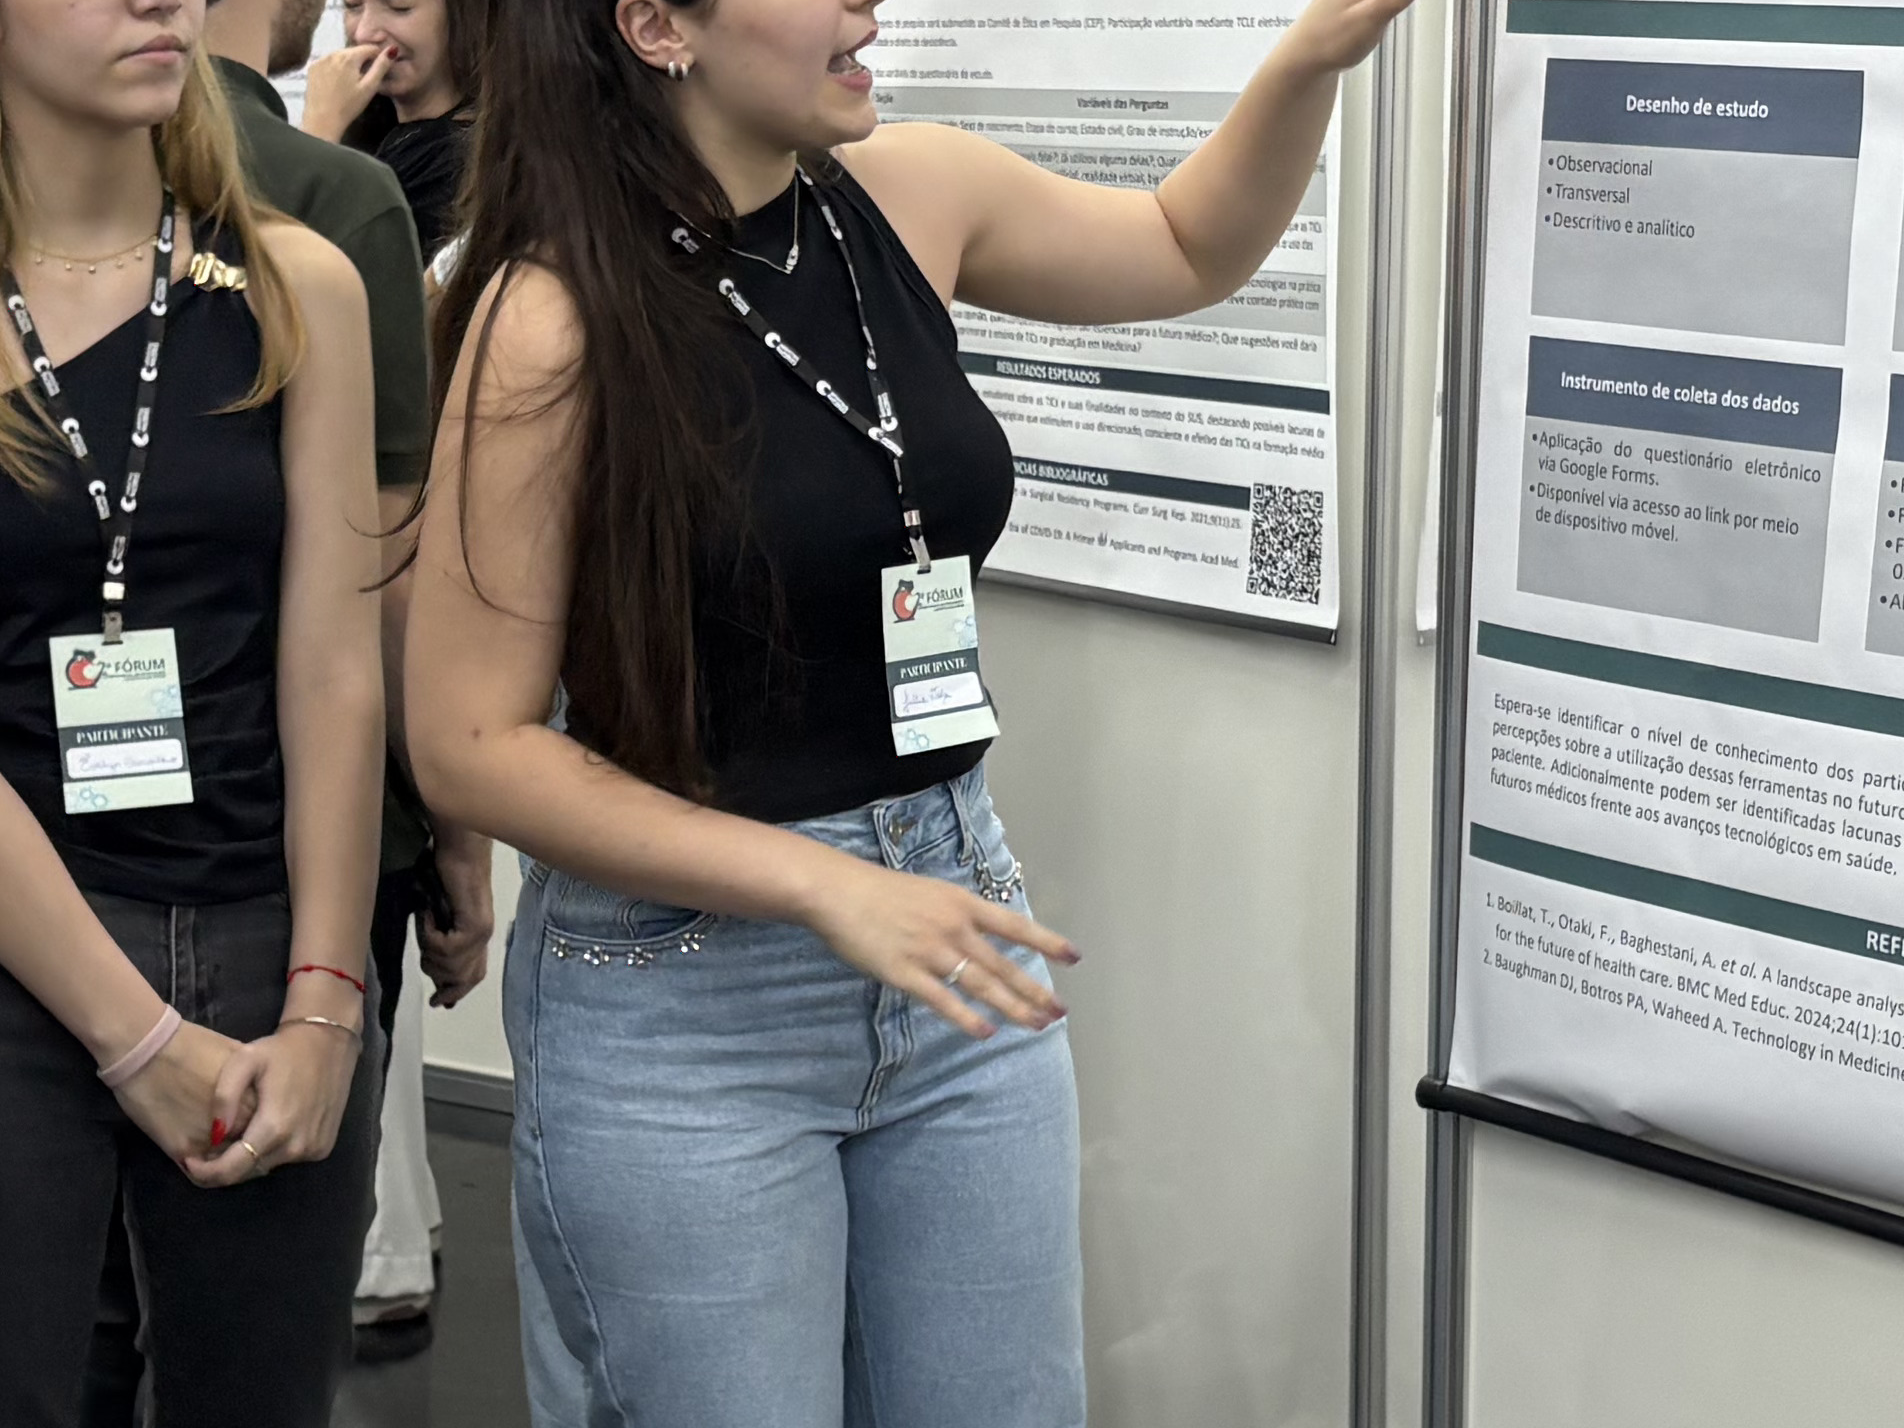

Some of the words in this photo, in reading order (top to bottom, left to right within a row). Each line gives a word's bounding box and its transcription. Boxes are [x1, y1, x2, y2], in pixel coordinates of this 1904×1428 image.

[1626, 94, 1690, 115] Desenho
[1693, 97, 1713, 116] de
[1716, 99, 1769, 119] estudo
[1560, 371, 1649, 397] Instrumento
[1651, 381, 1671, 400] de
[1673, 385, 1718, 405] coleta
[1721, 389, 1749, 409] dos
[1752, 392, 1800, 415] dados
[115, 658, 165, 673] FÓRUM
